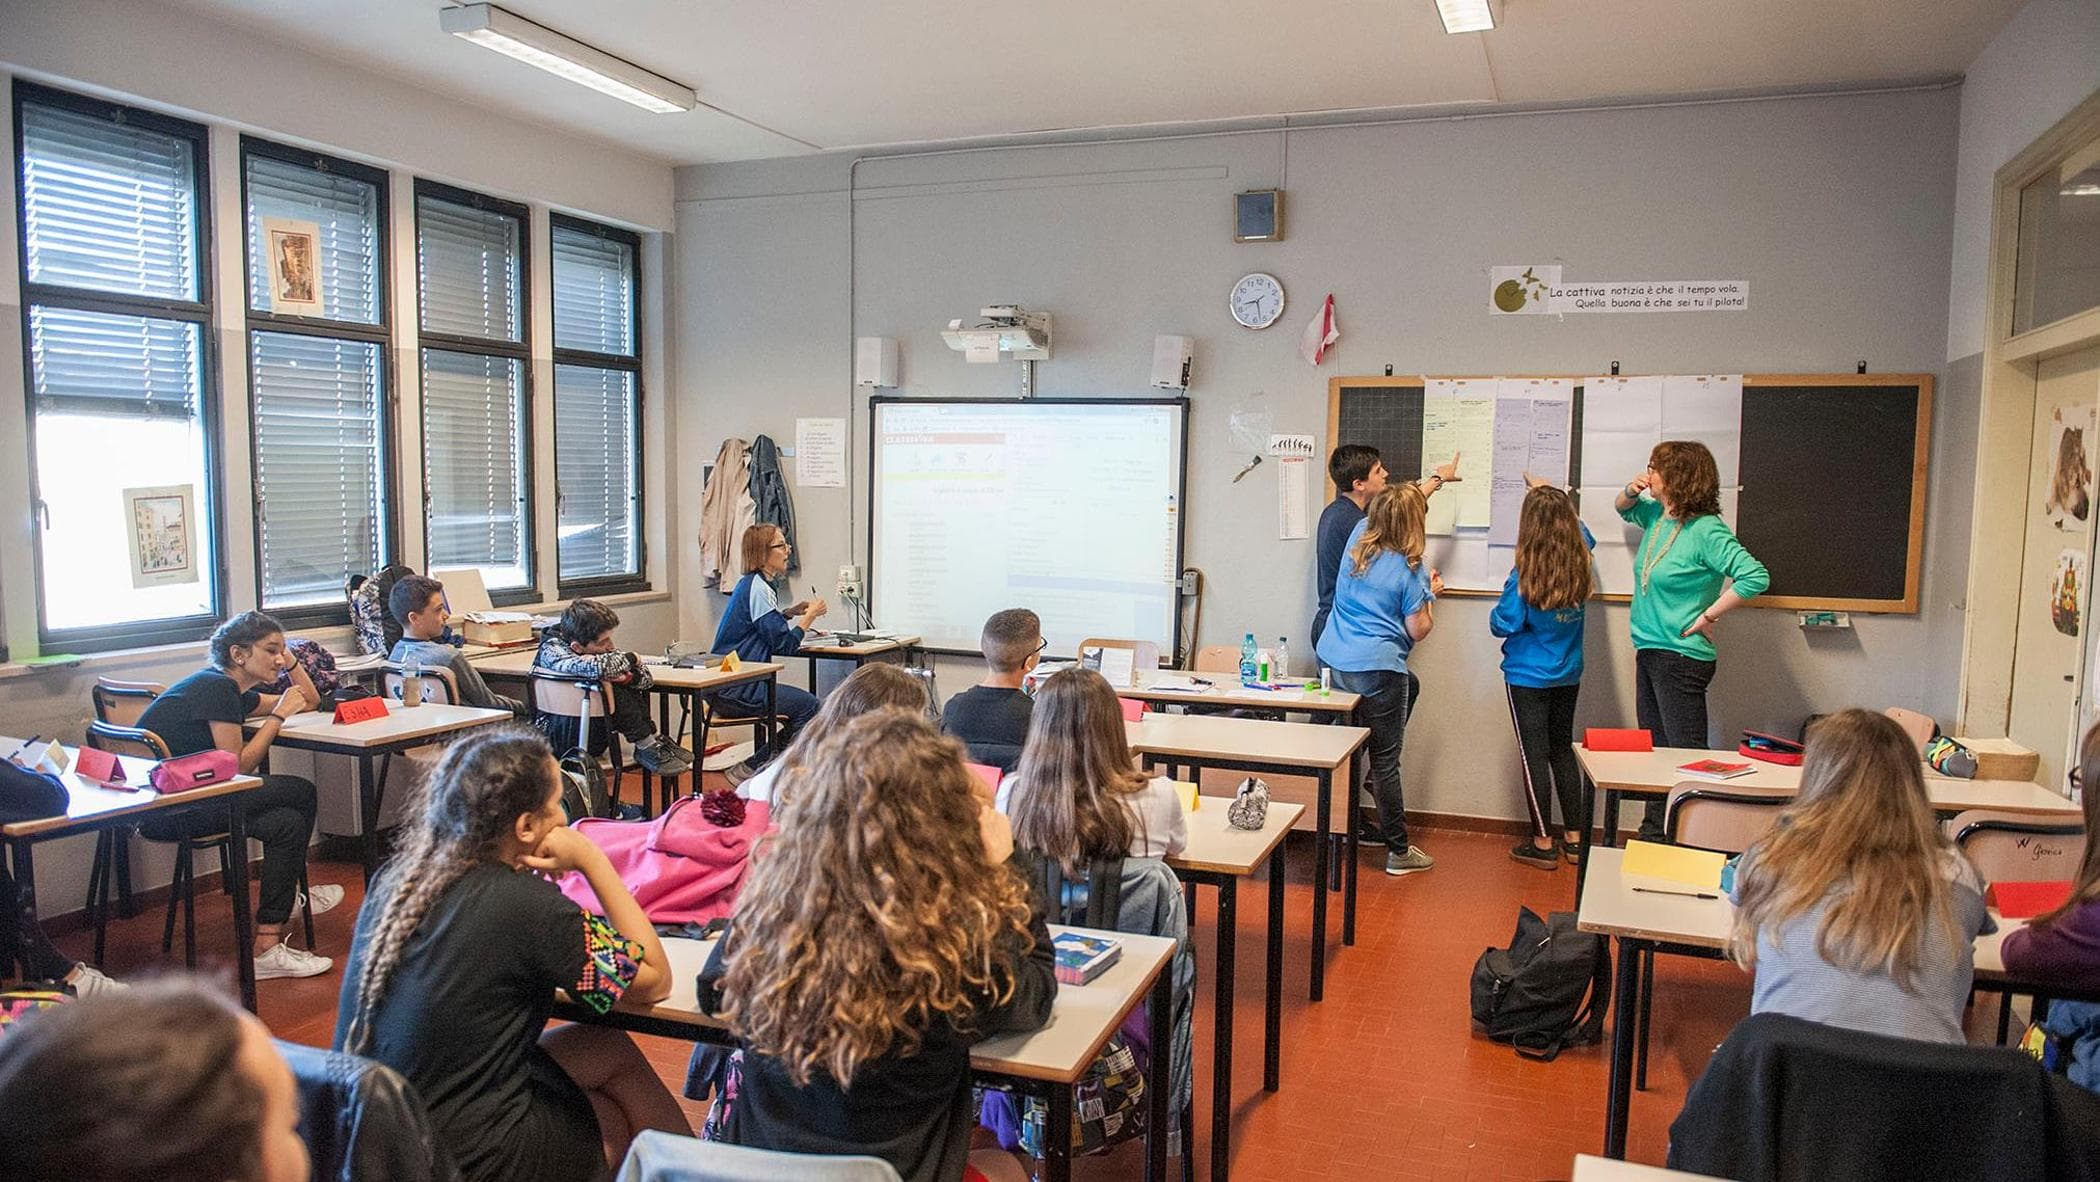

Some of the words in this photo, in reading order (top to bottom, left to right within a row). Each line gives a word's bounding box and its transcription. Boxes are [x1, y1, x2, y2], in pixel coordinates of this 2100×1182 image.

[1256, 278, 1264, 286] 12
[1550, 287, 1563, 298] La
[1566, 286, 1605, 297] cattiva
[1610, 286, 1644, 295] notizia
[1647, 285, 1653, 294] è
[1655, 285, 1674, 294] che
[1678, 285, 1684, 294] il
[1687, 286, 1716, 295] tempo
[1718, 284, 1740, 293] vola.
[1575, 298, 1606, 309] Quella
[1611, 297, 1641, 307] buona
[1644, 297, 1650, 307] è
[1653, 297, 1672, 307] che
[1677, 298, 1691, 307] sei
[1694, 299, 1704, 307] tu
[1706, 297, 1712, 306] il
[1715, 296, 1745, 308] pilota!
[2016, 836, 2031, 849] W
